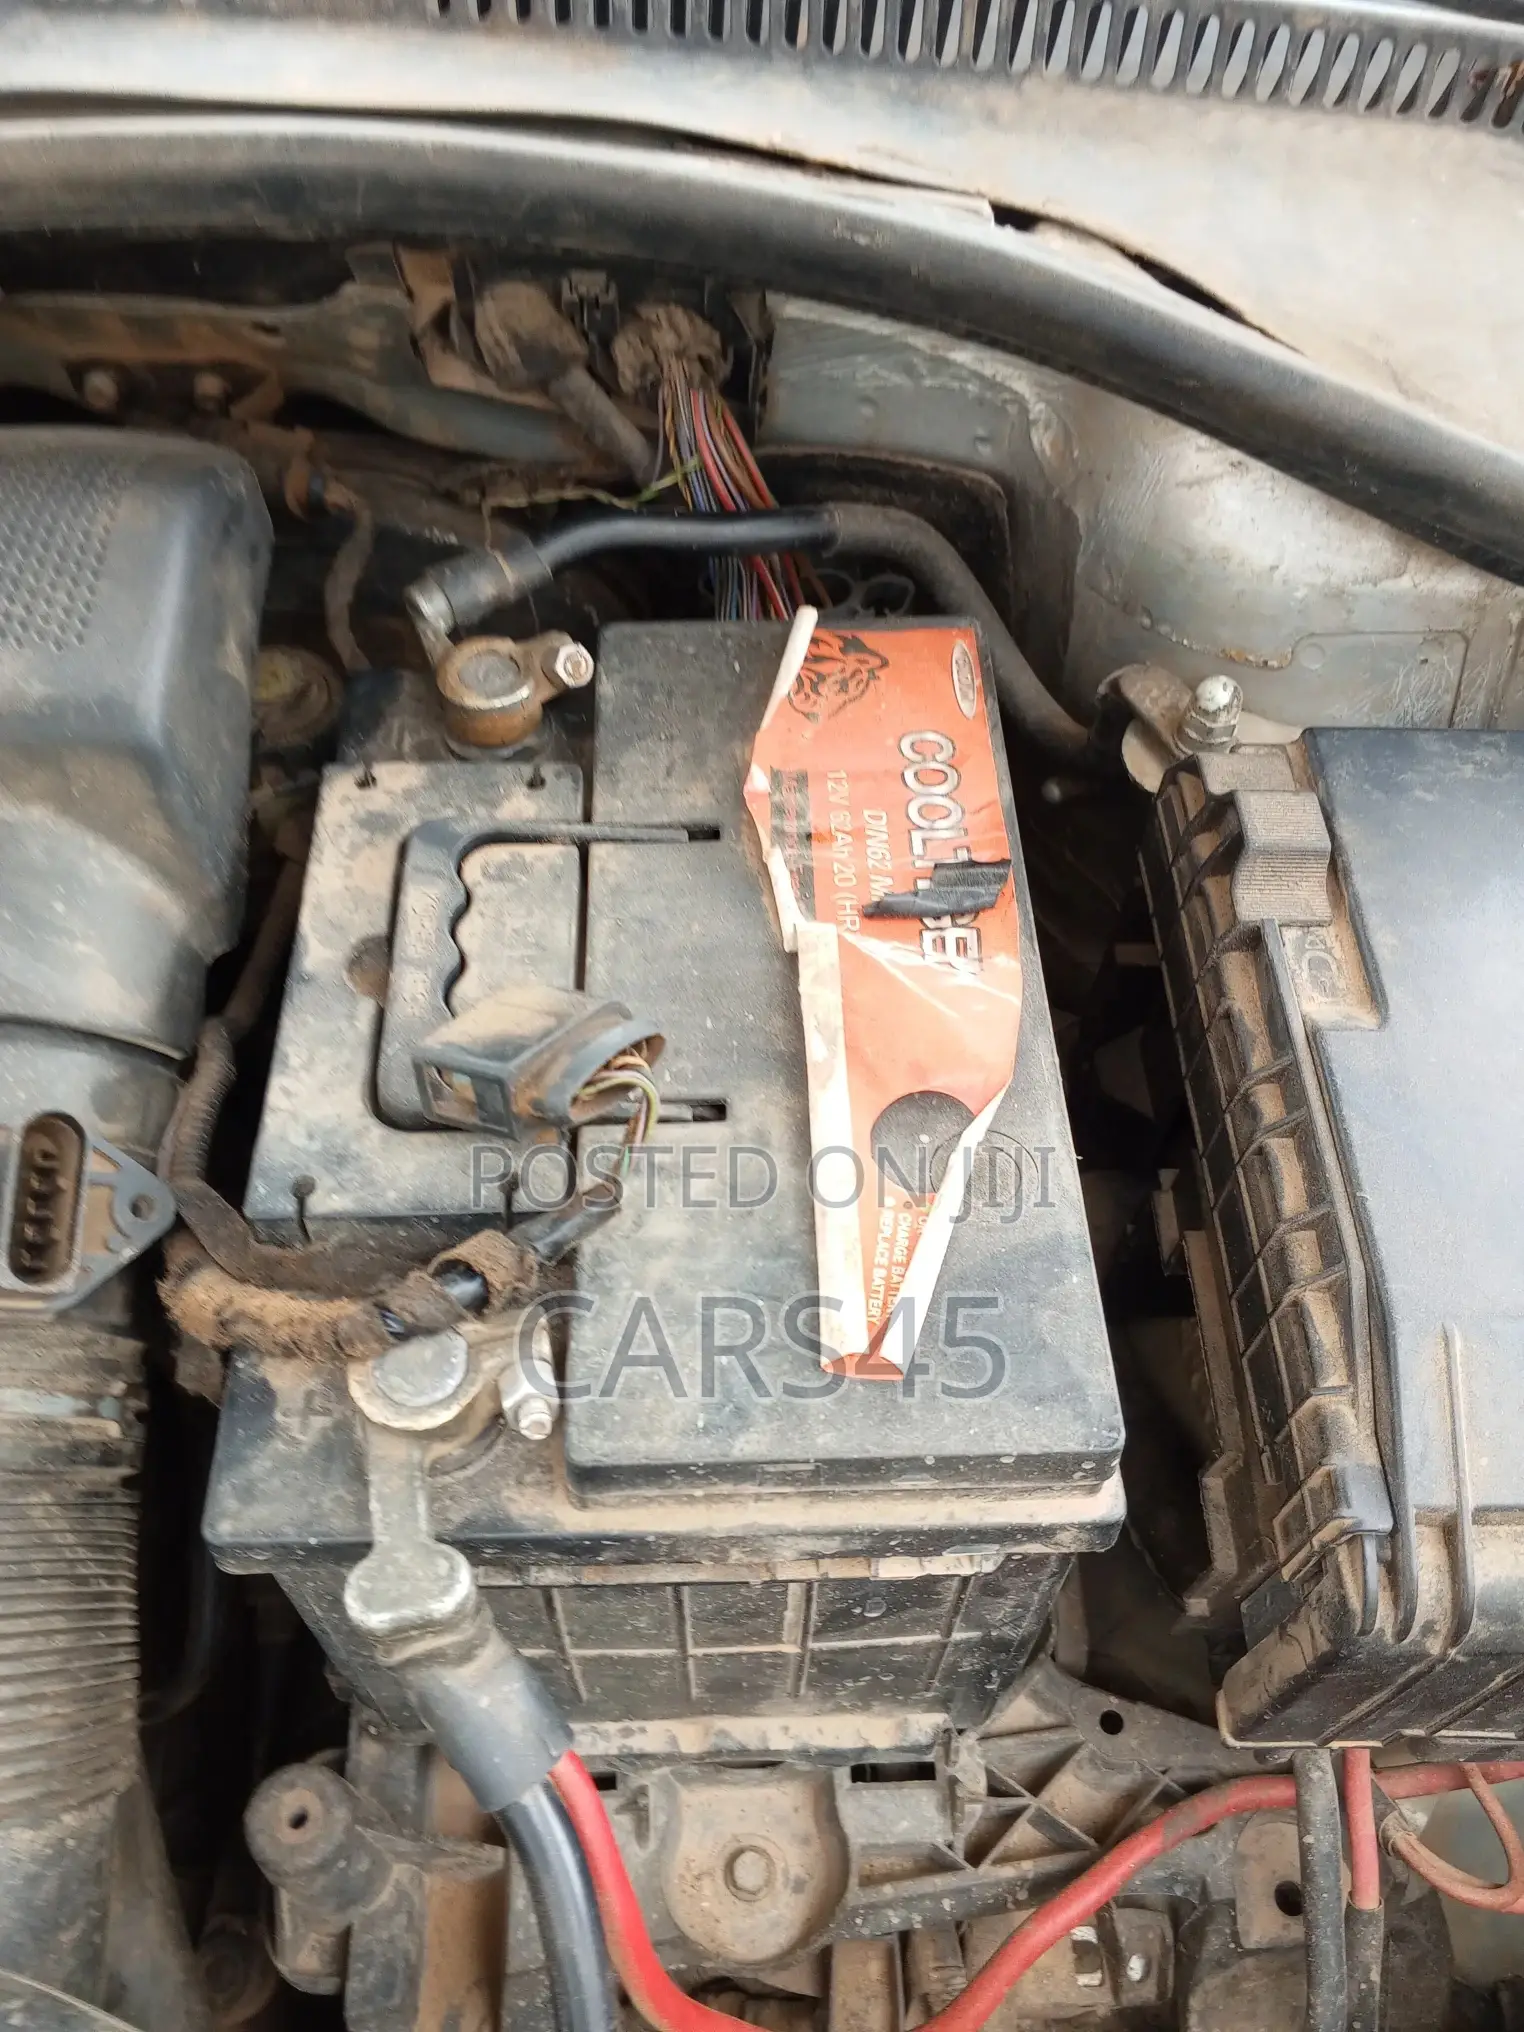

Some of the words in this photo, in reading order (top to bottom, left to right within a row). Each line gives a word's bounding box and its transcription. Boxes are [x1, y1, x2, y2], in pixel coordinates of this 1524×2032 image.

[826, 769, 852, 807] 12V
[829, 810, 855, 858] 62Ah
[862, 808, 892, 870] DIN62
[832, 861, 857, 887] 20
[875, 1208, 895, 1266] REPLACE
[894, 1213, 913, 1264] CHARGE
[866, 1266, 888, 1326] BATTERY
